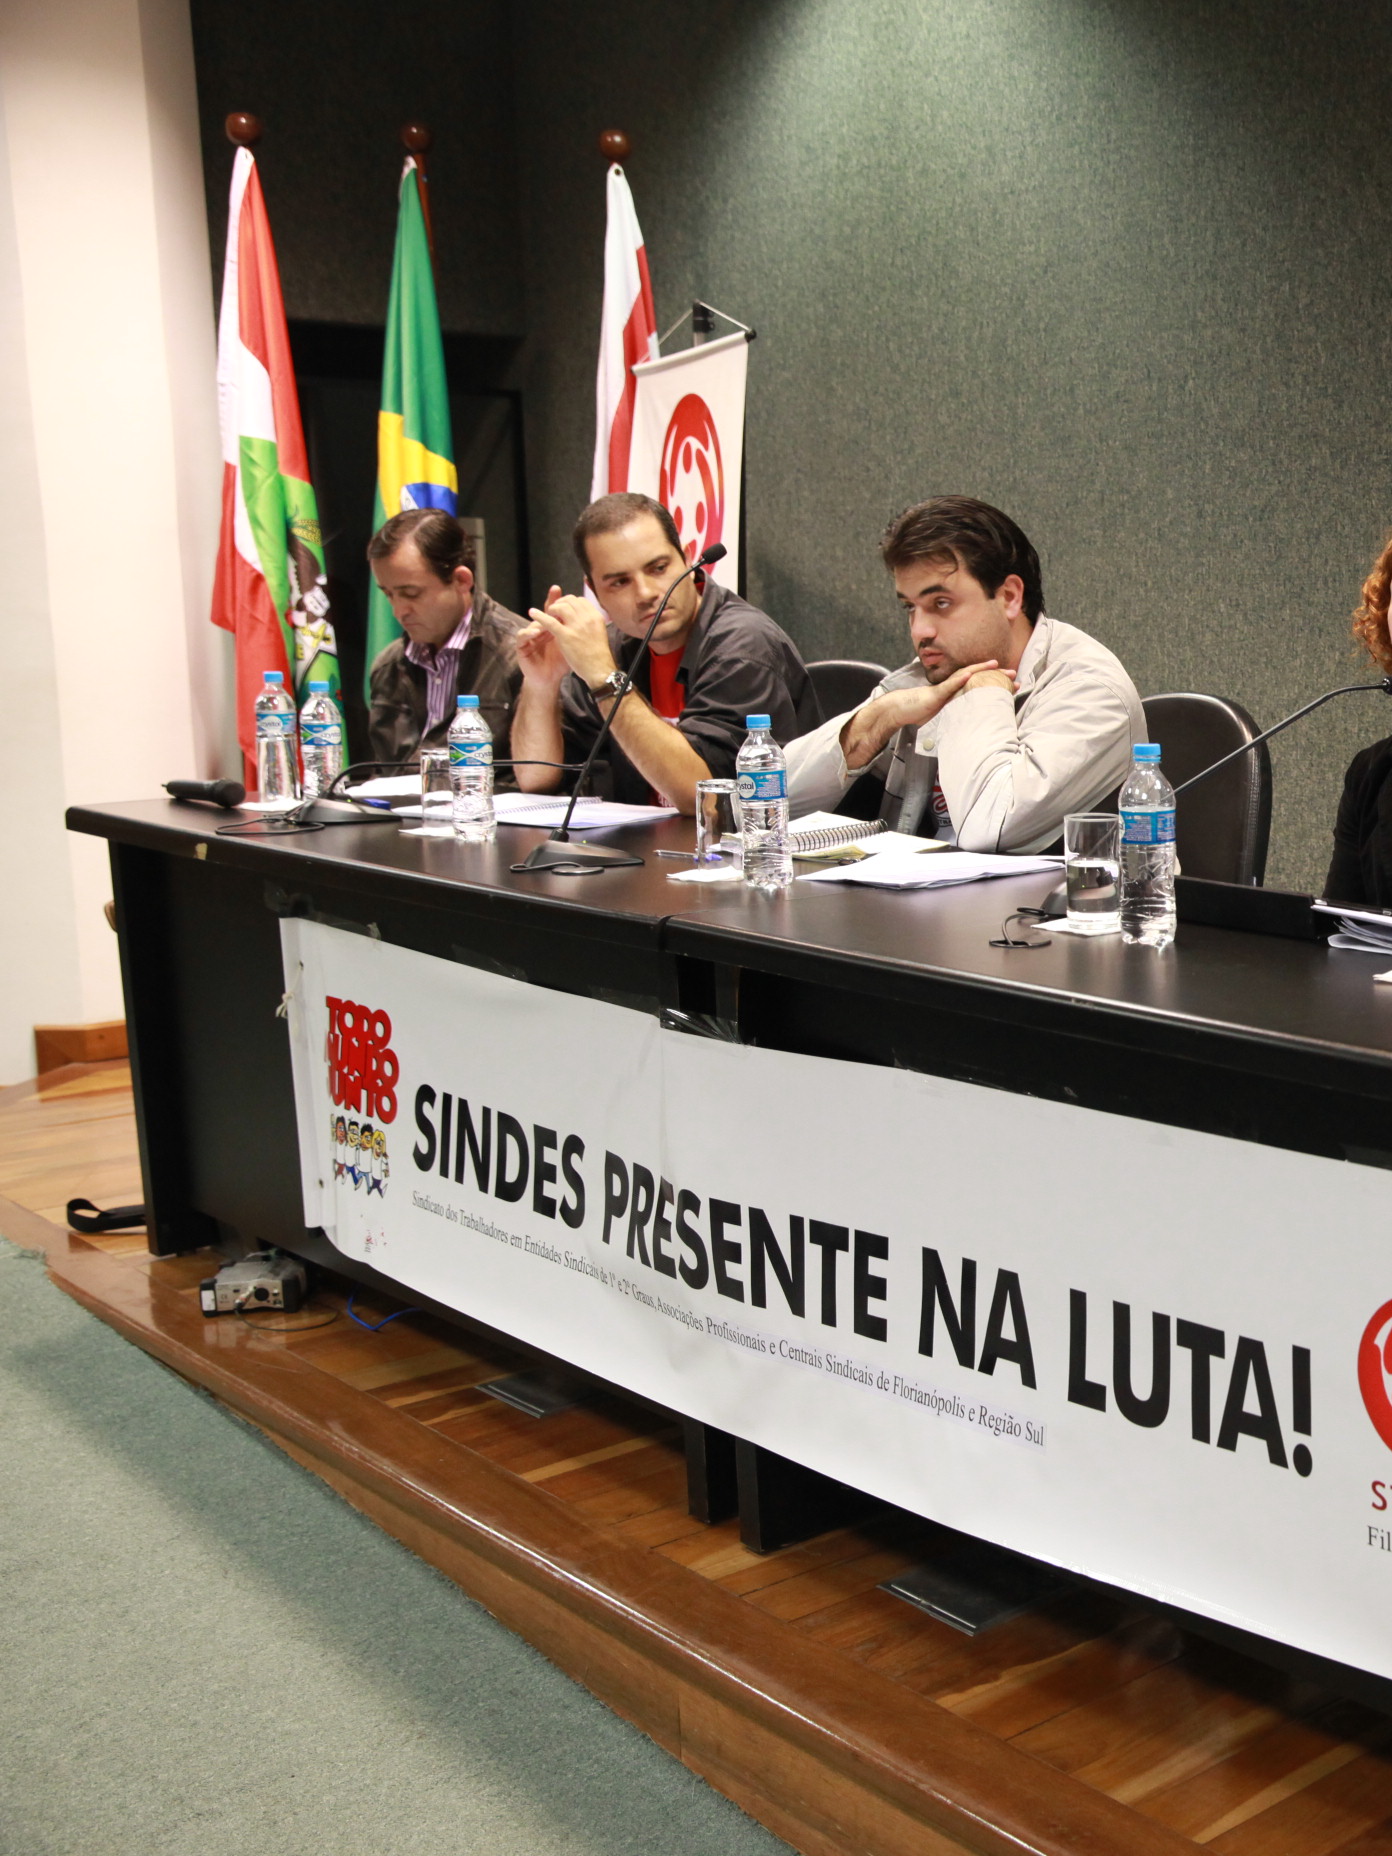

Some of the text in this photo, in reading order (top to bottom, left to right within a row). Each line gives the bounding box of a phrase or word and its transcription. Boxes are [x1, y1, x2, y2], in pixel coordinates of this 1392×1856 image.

[325, 995, 392, 1051] TODO
[327, 1062, 398, 1124] UNTO
[412, 1083, 1313, 1478] SINDES PRESENTE NA LUTA!
[412, 1190, 444, 1217] Sindicato
[446, 1203, 458, 1222] dos
[459, 1209, 509, 1244] Trabalhadores
[510, 1233, 522, 1249] em
[524, 1234, 562, 1265] Entidades
[564, 1250, 599, 1280] Sindicais
[600, 1266, 608, 1285] de
[617, 1279, 623, 1293] e
[705, 1315, 766, 1353] Profissionais
[769, 1340, 776, 1355] e
[779, 1339, 823, 1369] Centrais
[825, 1354, 874, 1386] Sindicais
[876, 1370, 890, 1392] de
[893, 1374, 965, 1419] Florianópolis
[968, 1407, 976, 1422] e
[978, 1405, 1022, 1437] Região
[1025, 1420, 1044, 1447] Sul
